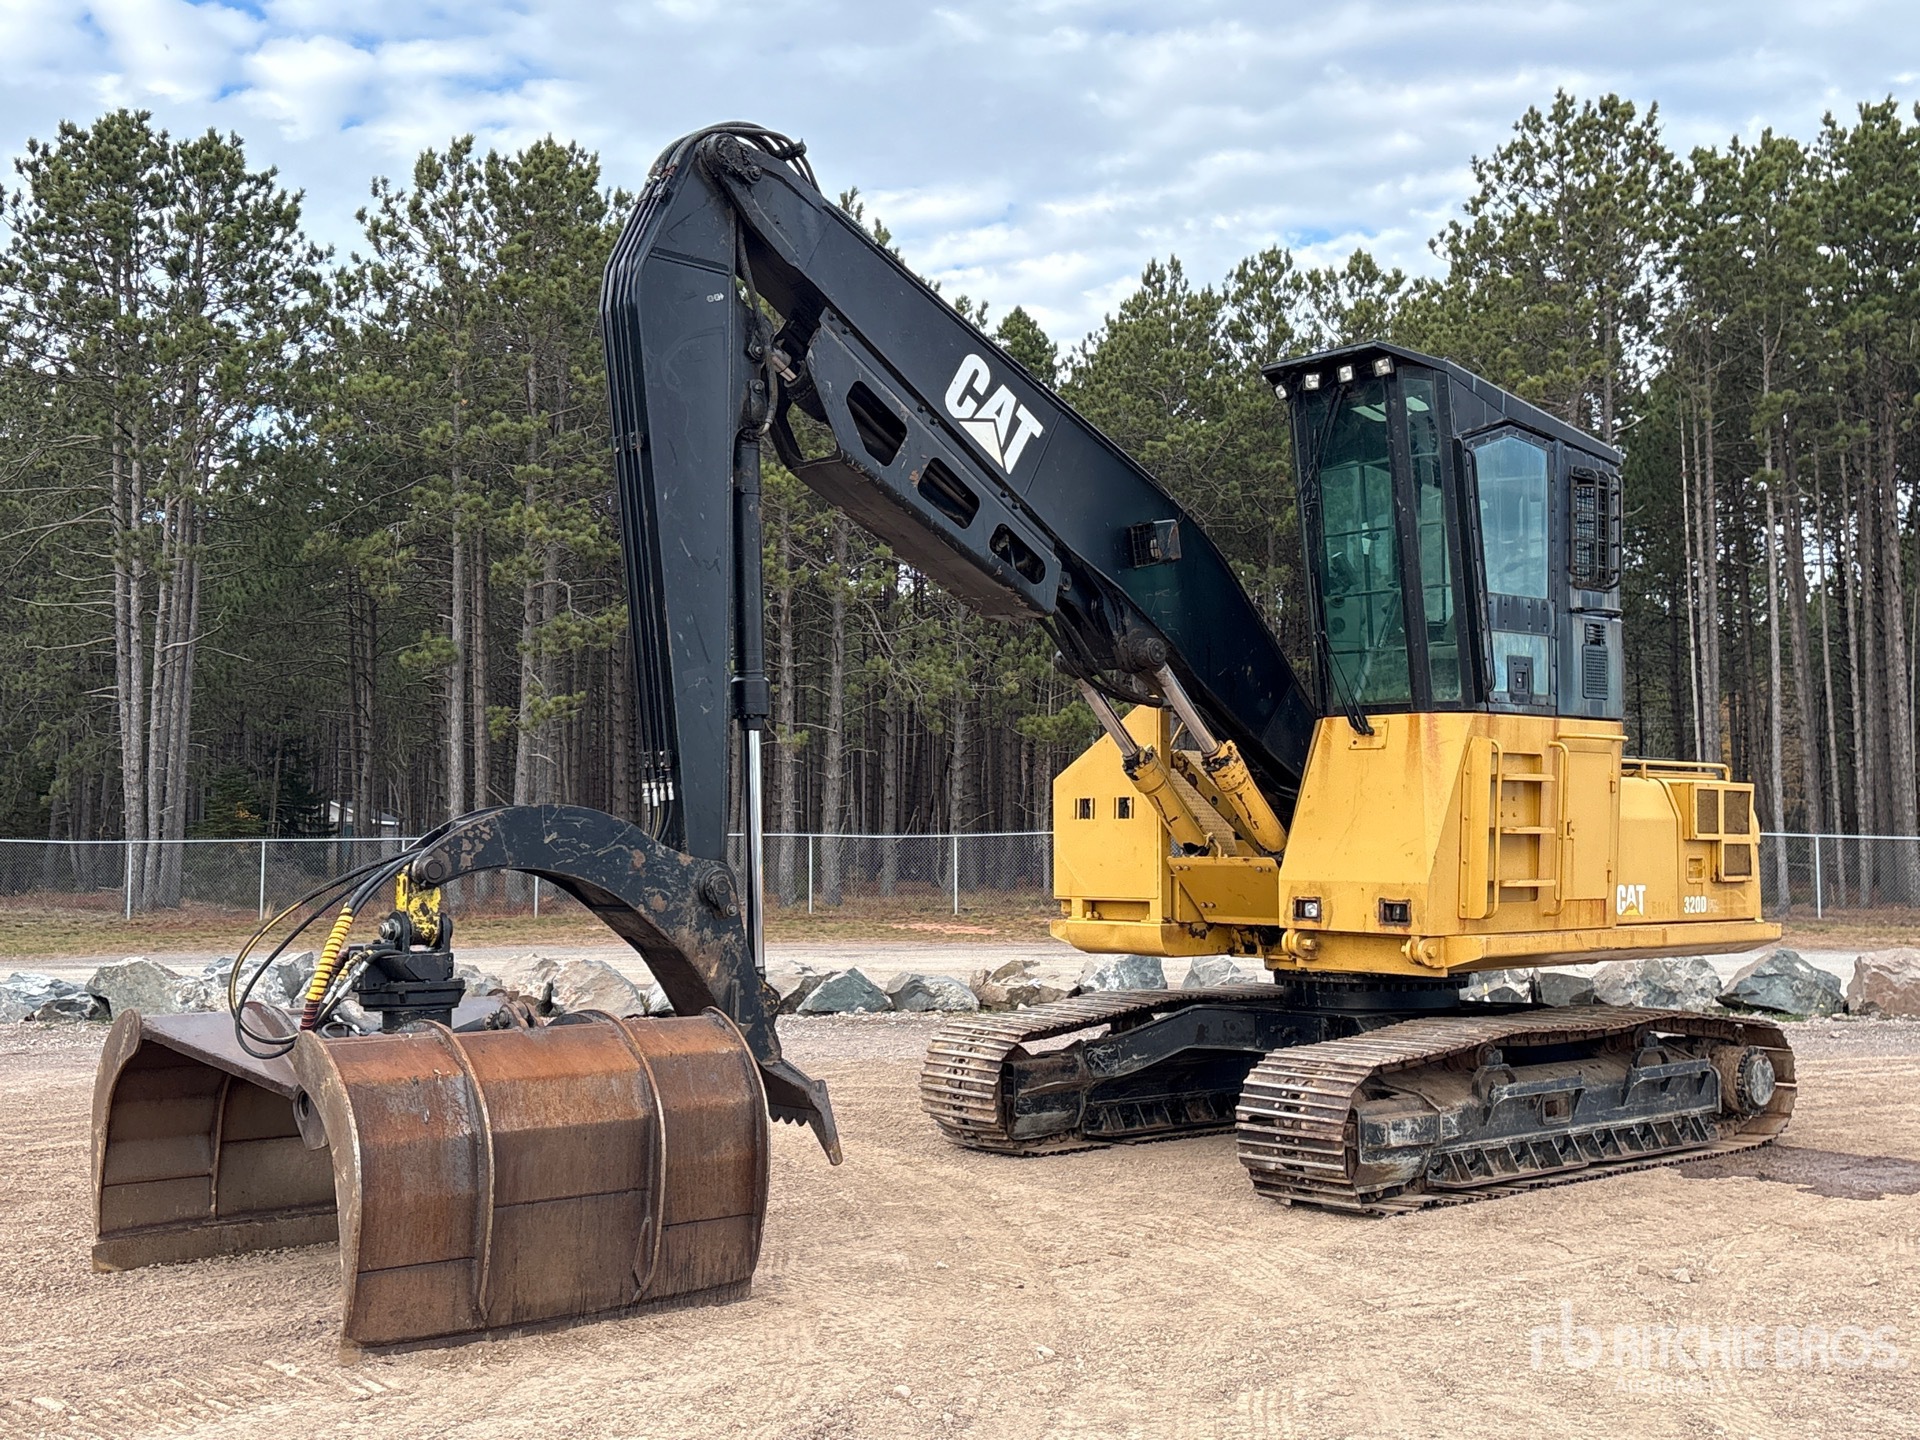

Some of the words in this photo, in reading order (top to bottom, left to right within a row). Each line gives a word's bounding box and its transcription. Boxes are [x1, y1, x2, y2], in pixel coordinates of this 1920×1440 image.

[945, 354, 1043, 474] CAT
[1616, 884, 1646, 916] CAT
[1683, 896, 1707, 914] 320D
